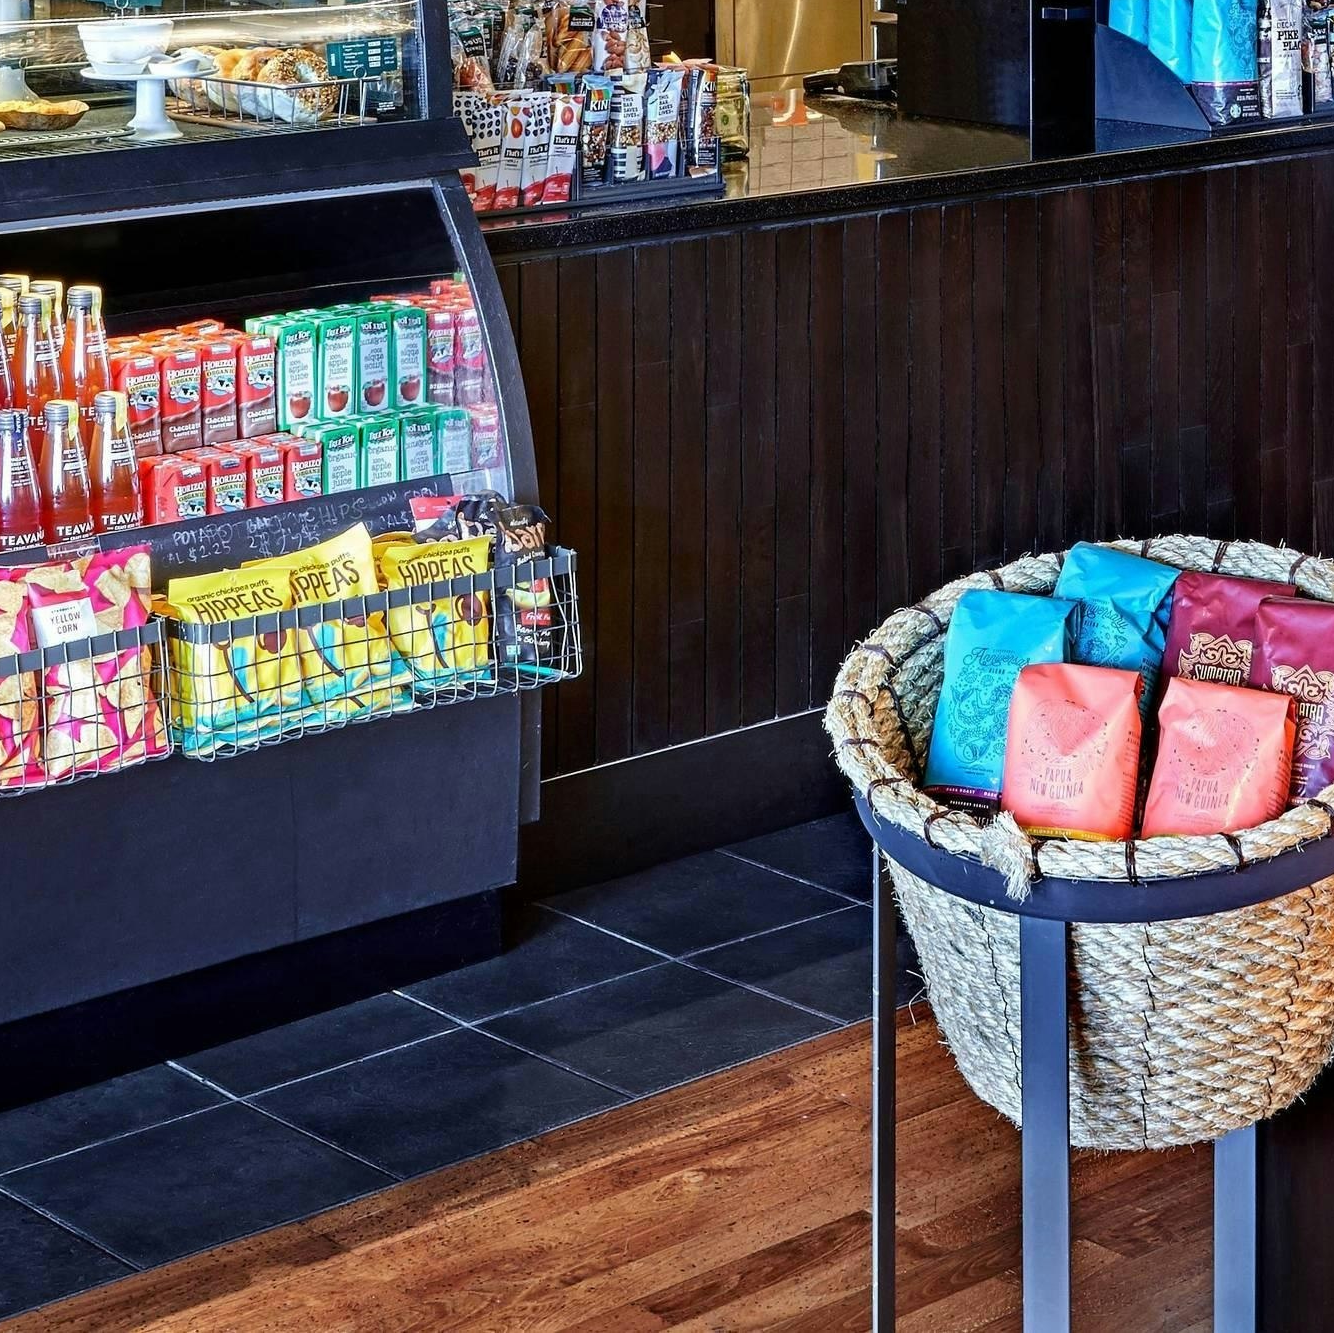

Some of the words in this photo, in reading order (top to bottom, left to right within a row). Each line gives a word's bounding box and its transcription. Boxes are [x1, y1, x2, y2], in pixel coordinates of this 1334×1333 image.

[1277, 31, 1299, 40] PIKE
[590, 100, 609, 111] KIN
[328, 358, 347, 368] apple
[329, 366, 348, 374] juice
[187, 592, 213, 603] organic
[215, 585, 249, 597] chickpea
[251, 579, 268, 590] puffs
[195, 586, 283, 625] HIPPEAS
[1195, 664, 1241, 686] SUMATRA
[1045, 768, 1072, 782] PAPUA
[1030, 778, 1048, 795] NEW
[1050, 782, 1084, 799] GUINEA
